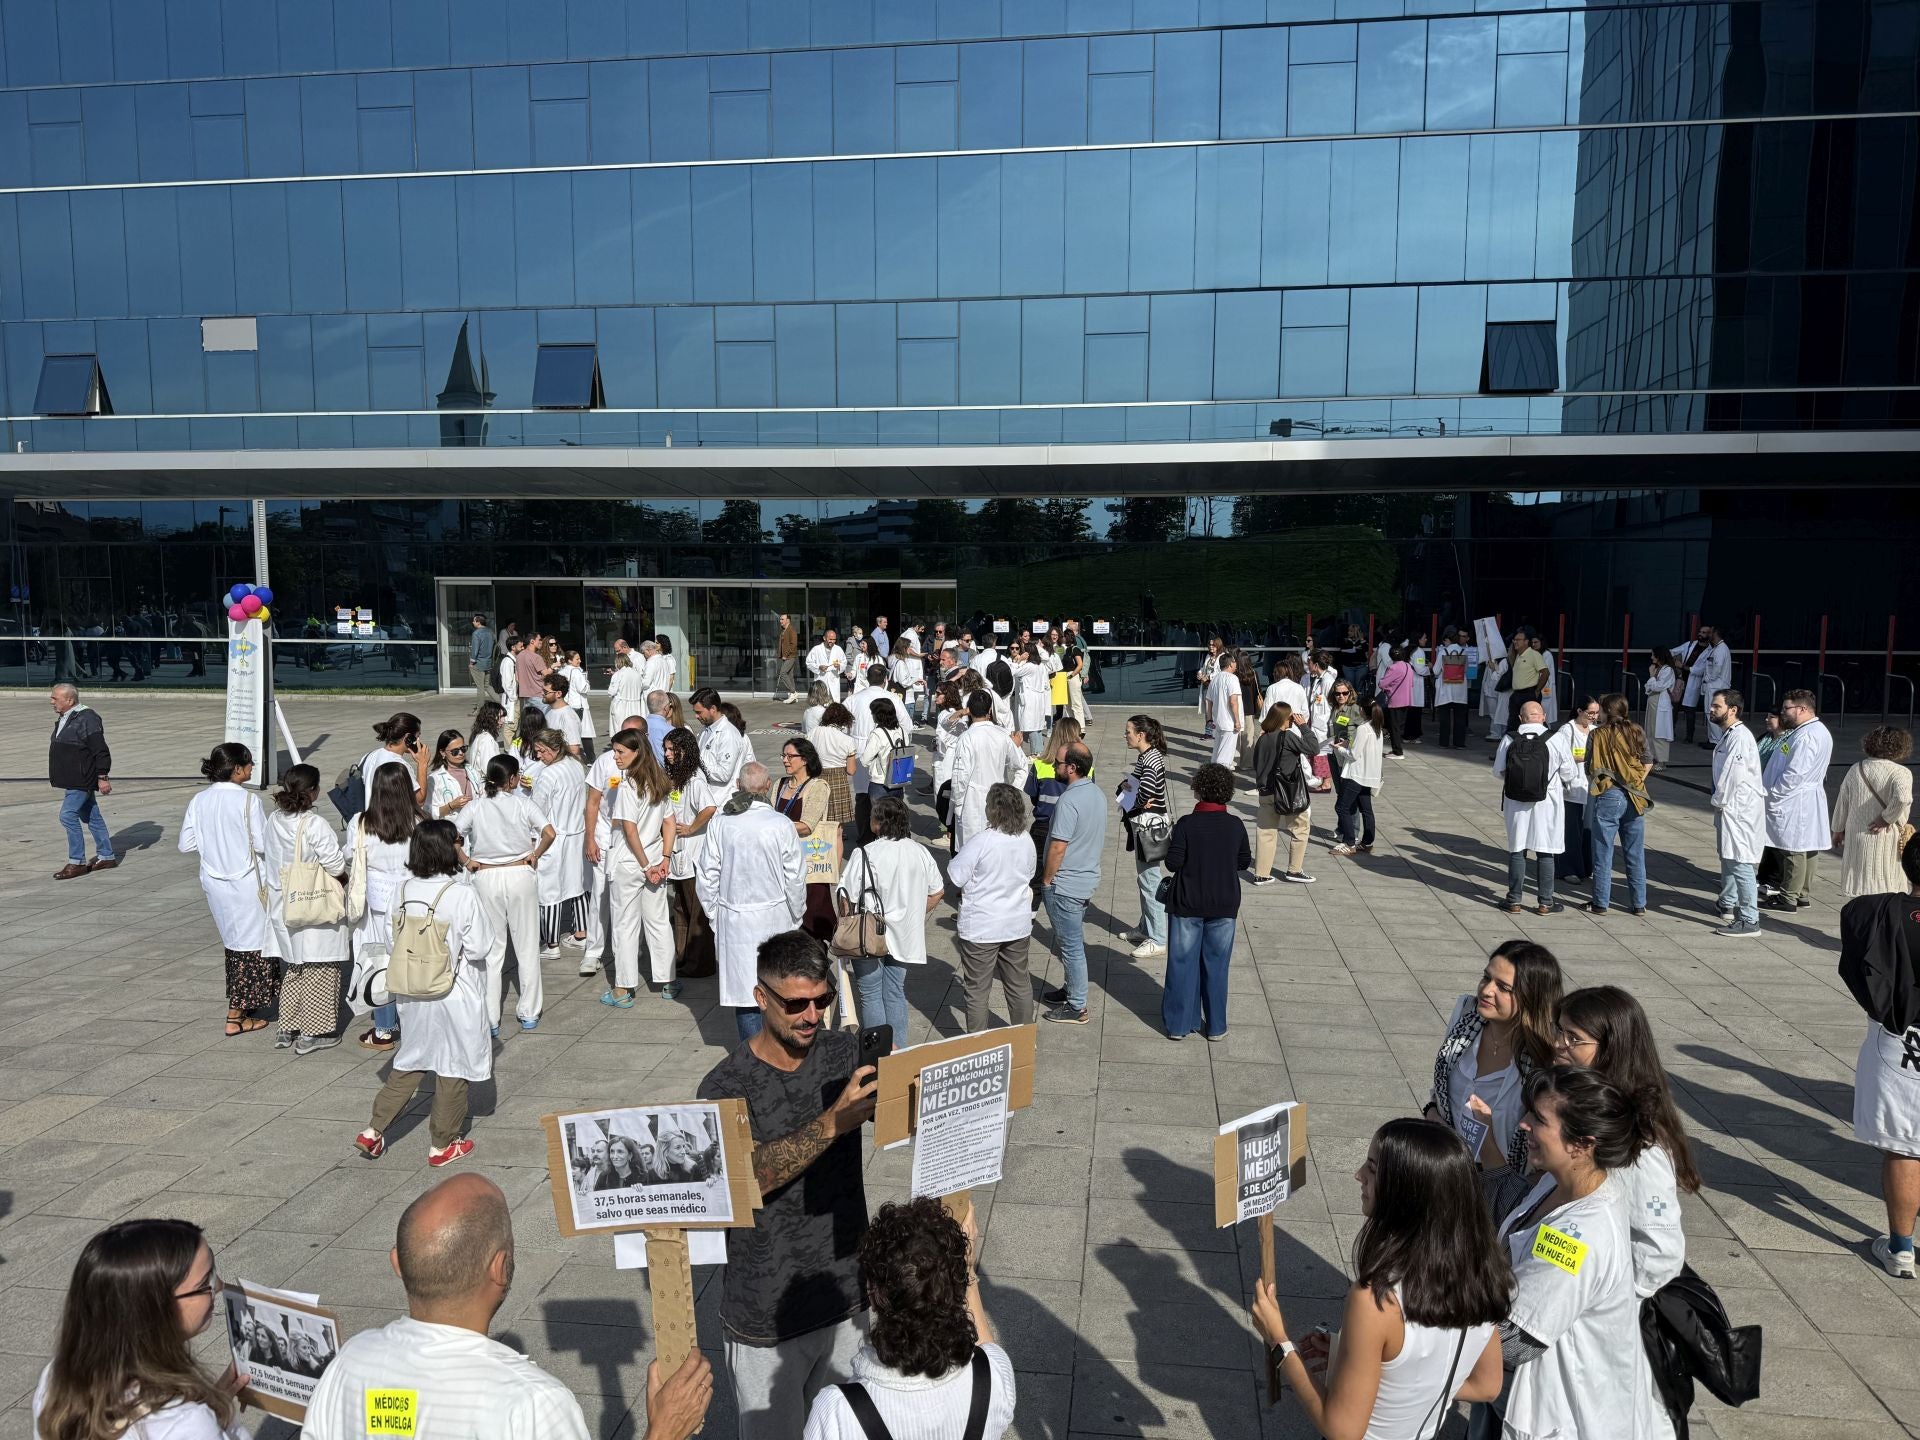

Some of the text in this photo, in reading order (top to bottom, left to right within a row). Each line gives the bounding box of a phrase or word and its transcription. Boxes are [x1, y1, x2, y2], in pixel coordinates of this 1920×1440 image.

[924, 1050, 1004, 1084] 3 DE OCTUBRE
[924, 1064, 1004, 1094] HUELGA NACIONAL DE
[922, 1075, 1003, 1114] MÉDICOS
[922, 1116, 934, 1126] POR
[935, 1113, 947, 1121] UNA
[962, 1103, 980, 1112] TODOS
[1244, 1150, 1280, 1181] MÉDICA
[1244, 1170, 1282, 1196] 3 DE OCTURE
[594, 1190, 705, 1207] 37,5 horas semanales,
[596, 1202, 706, 1219] salvo que seas médico
[1244, 1205, 1266, 1218] SANIDAD
[1543, 1230, 1578, 1255] MÉDIC@S
[1536, 1243, 1576, 1270] EN HUELGA
[249, 1366, 263, 1378] 37,5
[264, 1370, 284, 1384] horas
[252, 1378, 269, 1389] salvo
[269, 1385, 283, 1394] que
[284, 1389, 301, 1398] seas
[375, 1393, 409, 1412] MÉDIC@S
[371, 1416, 412, 1430] EN HUELGA
